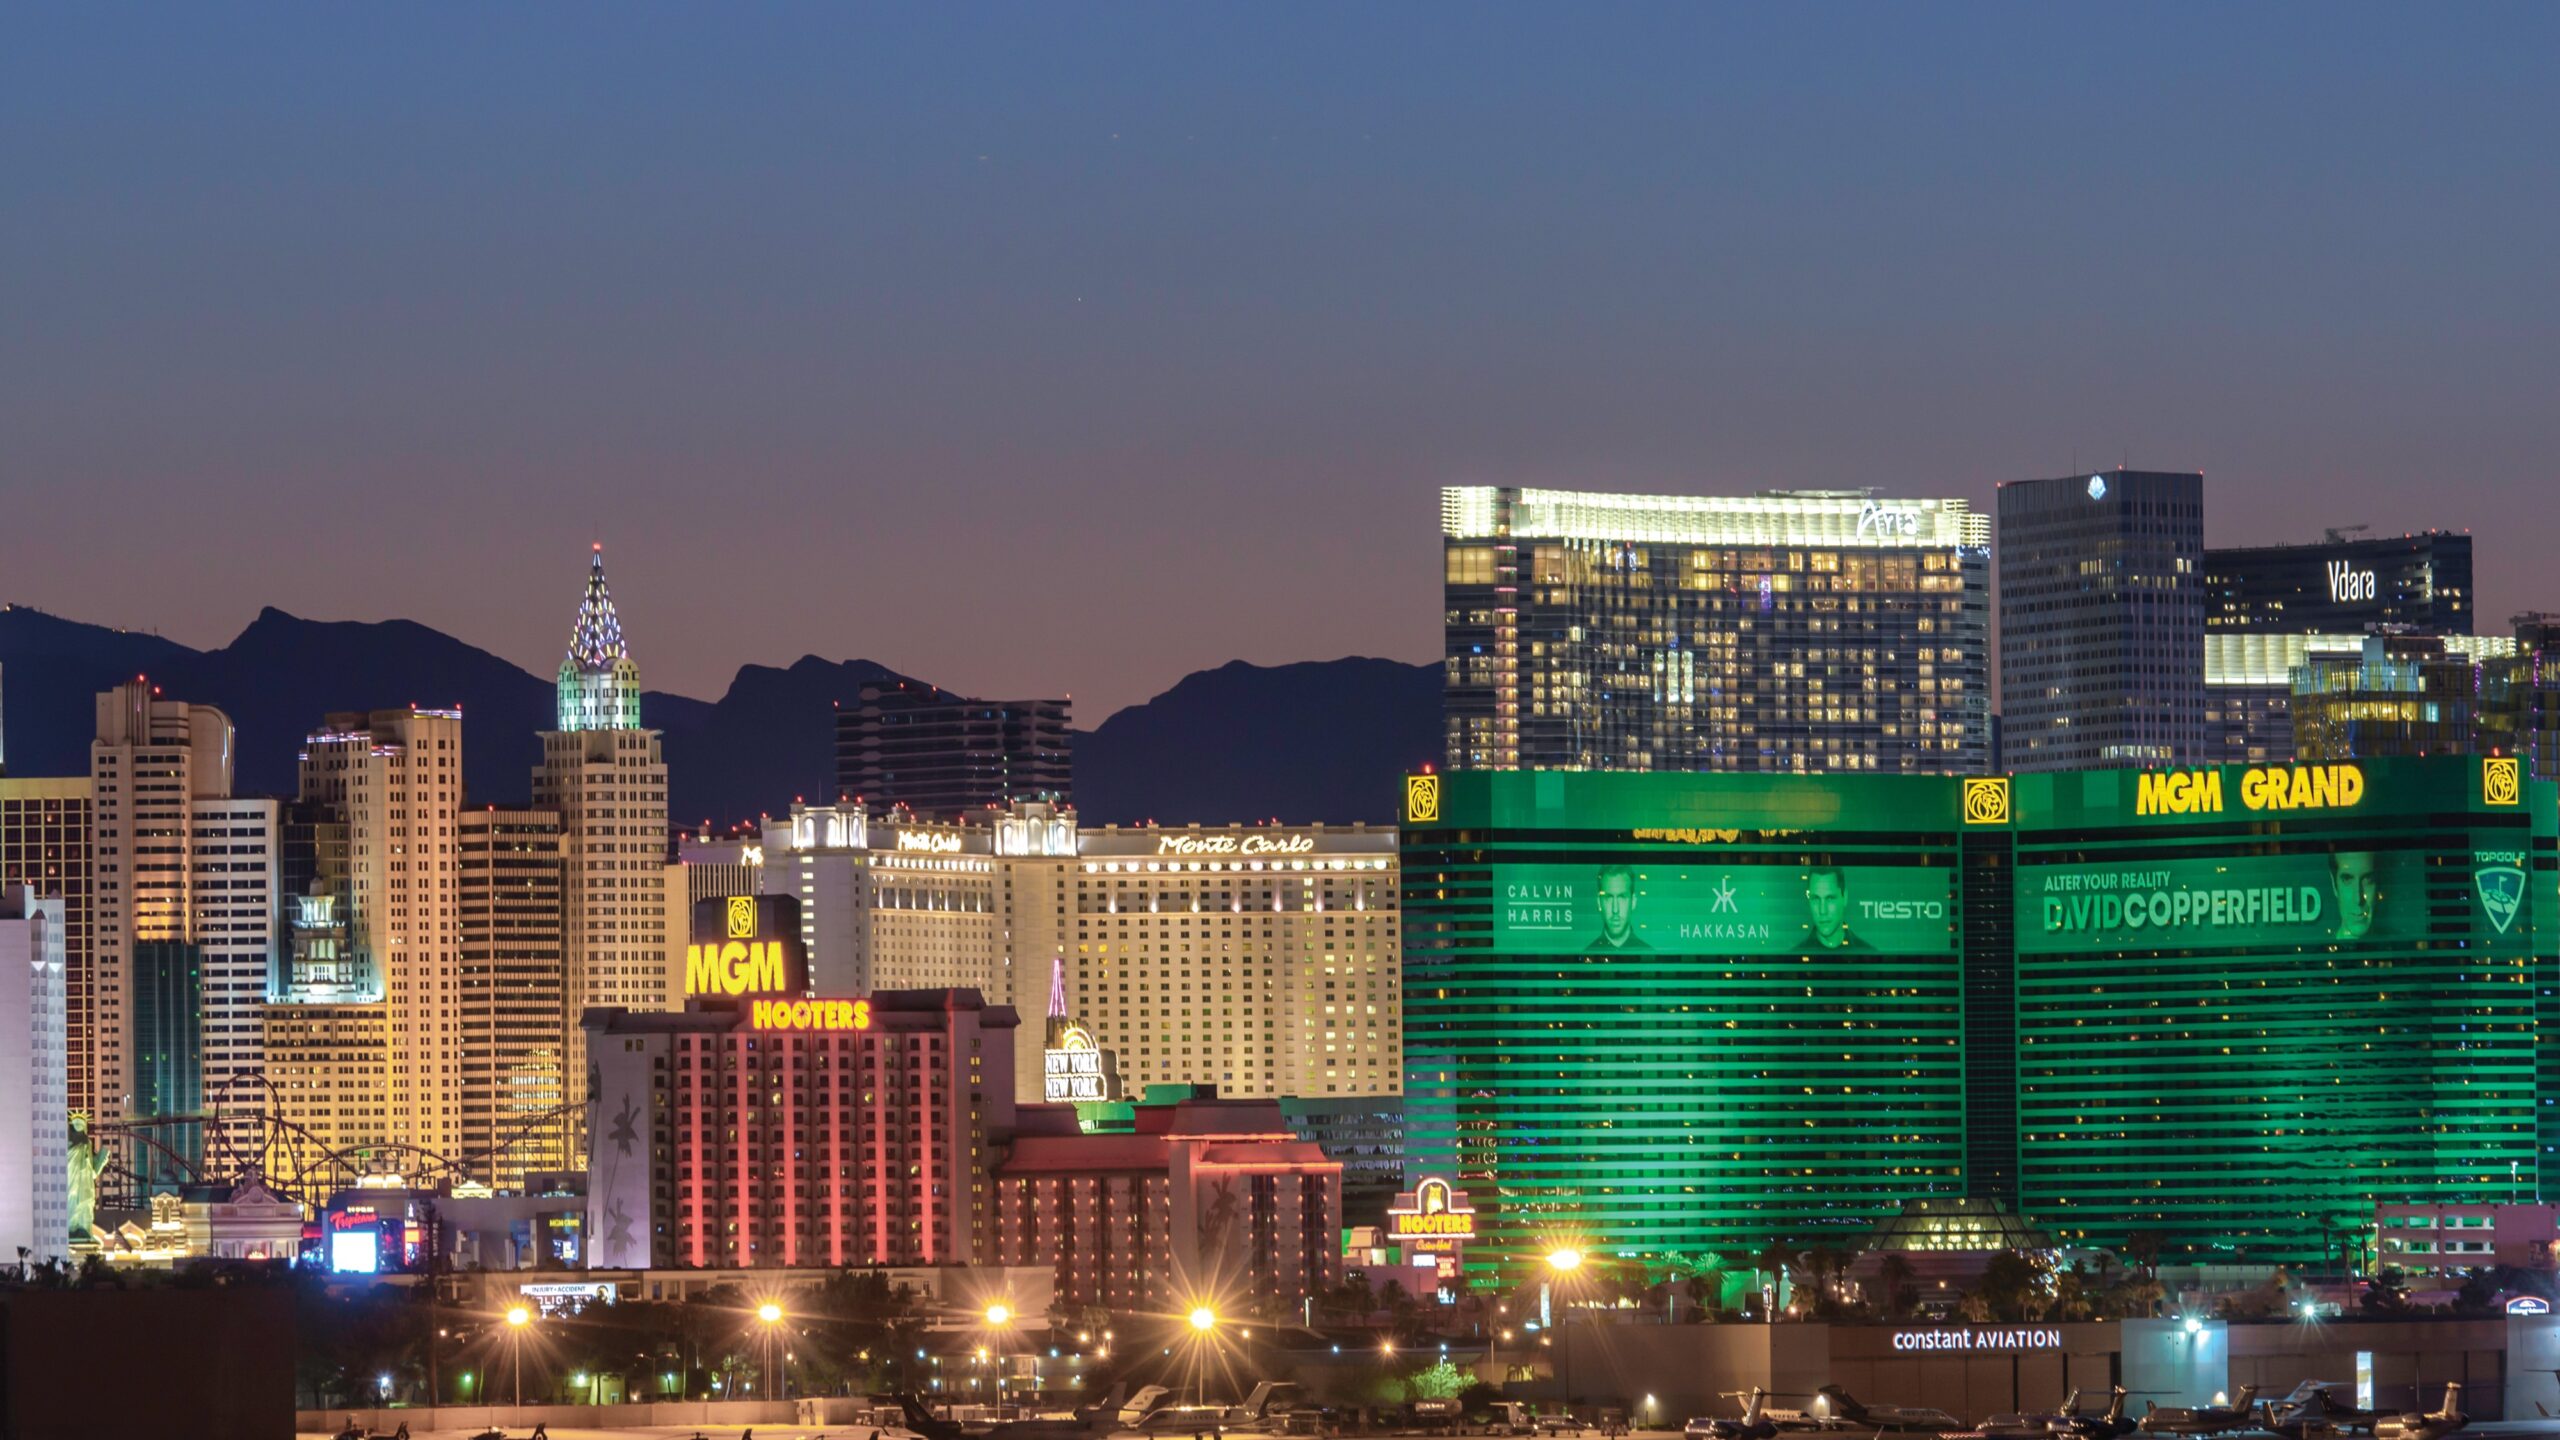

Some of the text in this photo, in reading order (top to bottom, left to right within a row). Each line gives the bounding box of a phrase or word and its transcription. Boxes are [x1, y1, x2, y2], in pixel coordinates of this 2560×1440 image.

[1856, 499, 1919, 538] Aria
[2327, 560, 2375, 602] Vdara
[2136, 764, 2364, 815] MGM GRAND
[1158, 834, 1314, 855] Monte Carlo
[2474, 851, 2526, 862] TOPGOLF
[1508, 884, 1573, 898] CALVIN
[2044, 871, 2171, 892] ALTER YOUR REALITY
[1508, 909, 1573, 922] HARRIS
[1680, 924, 1769, 938] HAKKASAN
[685, 941, 786, 996] MGM
[752, 1000, 871, 1030] HOOTERS
[1045, 1053, 1099, 1073] NEW YORK
[1045, 1077, 1099, 1097] NEW YORK
[1399, 1214, 1472, 1233] HOOTERS
[558, 1285, 586, 1293] ACCIDENT
[1893, 1329, 2061, 1350] constant AVIATION
